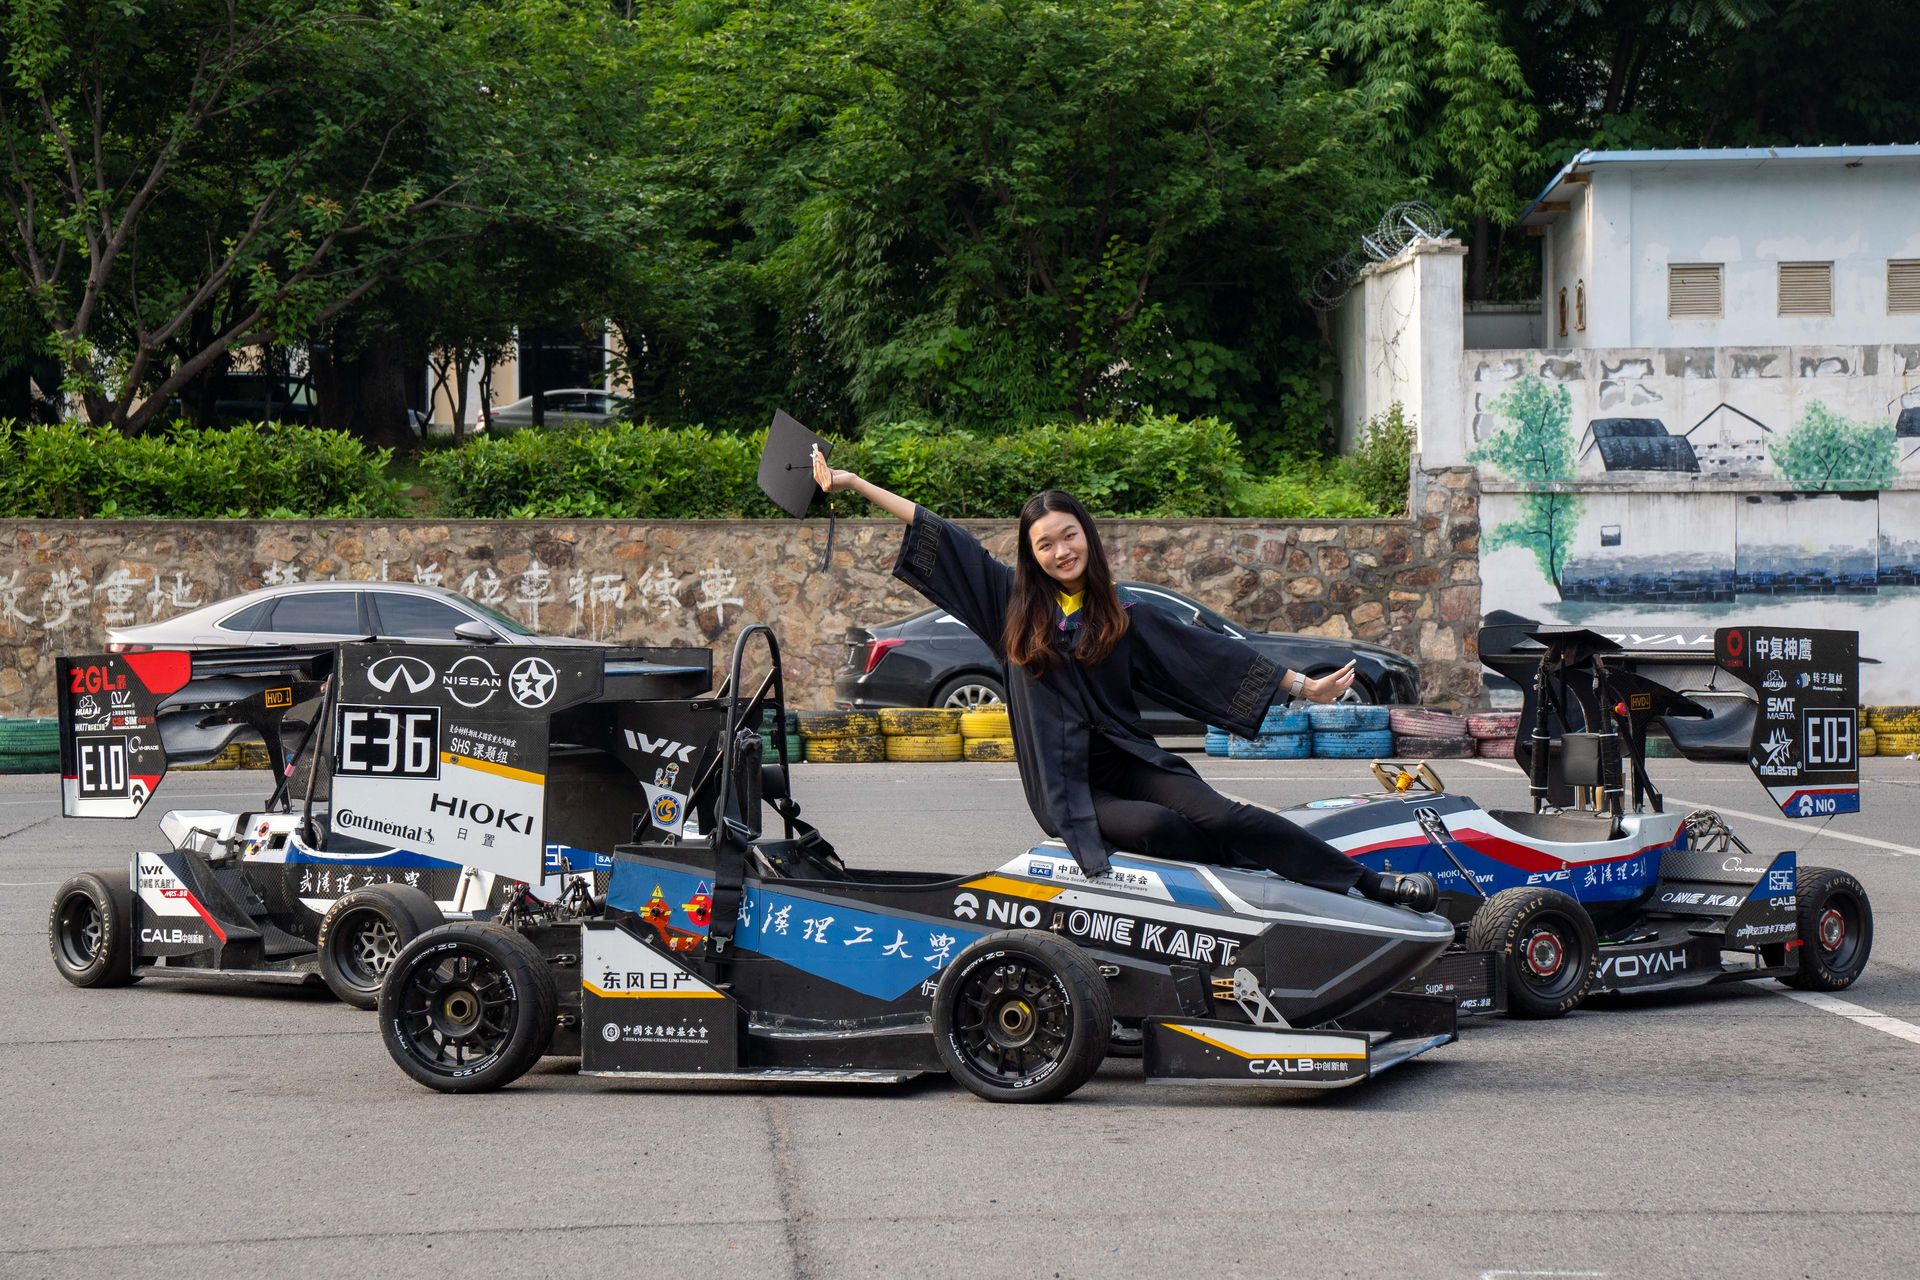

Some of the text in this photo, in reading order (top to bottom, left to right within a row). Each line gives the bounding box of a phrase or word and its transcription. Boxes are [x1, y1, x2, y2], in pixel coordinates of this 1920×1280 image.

[1756, 636, 1812, 661] 中复神鹰
[70, 665, 115, 693] ZGL
[443, 675, 501, 687] NISSAN
[1767, 697, 1796, 712] SMT
[1767, 712, 1796, 720] MASTA
[342, 711, 432, 773] E36
[450, 737, 509, 764] SHS 课题组
[1816, 798, 1836, 812] NIO
[430, 793, 534, 835] HIOKI
[336, 808, 423, 842] Continental
[598, 855, 613, 863] SA
[1031, 867, 1050, 876] SAE
[1437, 869, 1460, 879] HIOKI
[1526, 869, 1571, 885] EVE
[139, 879, 176, 888] ONE KART
[1661, 892, 1748, 907] ONE KA
[1769, 895, 1797, 907] CALB
[986, 901, 1041, 928] NIO
[141, 928, 182, 942] CALB
[1068, 909, 1241, 967] ONE KART
[960, 957, 984, 977] RACING
[603, 971, 692, 989] 东风日产
[474, 1054, 499, 1074] RACING
[1248, 1058, 1349, 1073] CALB 中创新航
[1014, 1061, 1058, 1088] OZ RACING
